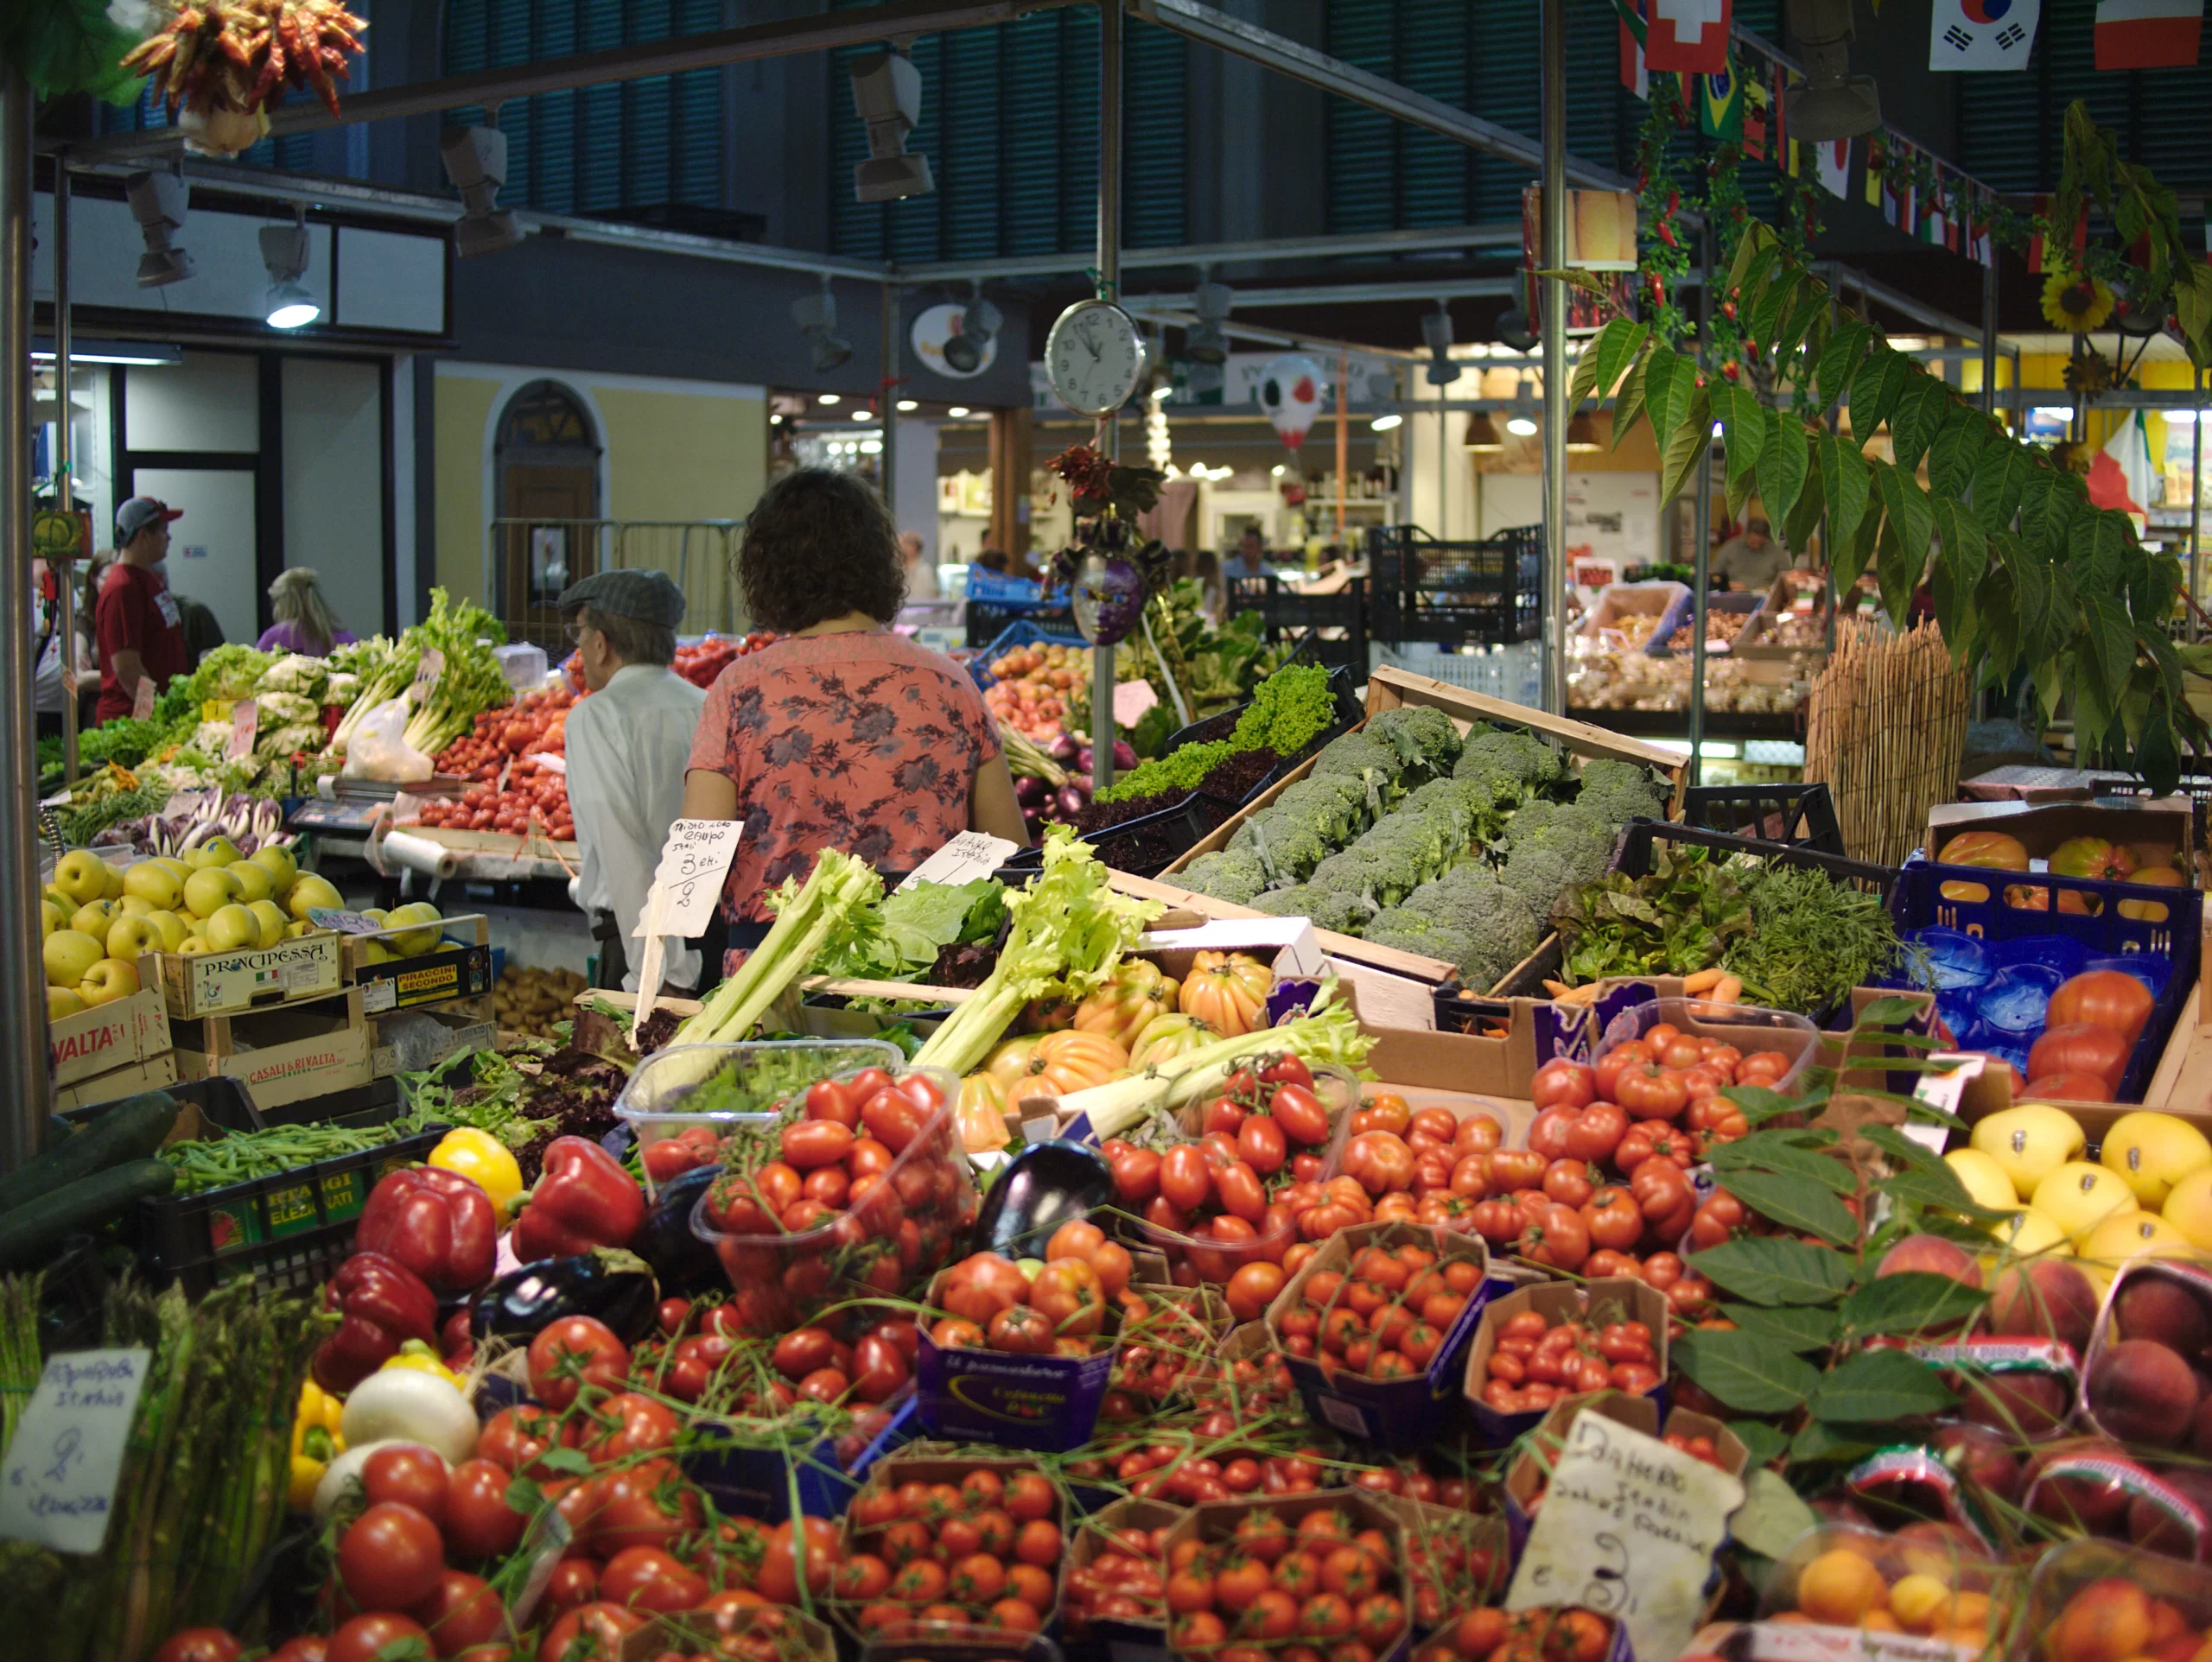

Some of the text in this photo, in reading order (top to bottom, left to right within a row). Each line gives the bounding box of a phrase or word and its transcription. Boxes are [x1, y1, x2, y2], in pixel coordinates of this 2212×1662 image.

[1085, 313, 1100, 326] 12
[1107, 317, 1114, 328] 1
[1118, 328, 1128, 341] 2
[1062, 339, 1076, 351] 10
[1126, 347, 1135, 360] 3
[1061, 359, 1070, 372] 9
[1124, 368, 1132, 378] 4
[1068, 377, 1077, 390] 8
[1114, 384, 1122, 396] 5
[1079, 390, 1089, 403] 7
[1098, 393, 1107, 405] 6
[681, 853, 696, 875] 3
[677, 881, 695, 908] 2
[398, 966, 456, 984] PIRACCINI
[402, 974, 454, 991] SECONDO
[250, 1063, 286, 1083] CASALI
[295, 1052, 337, 1071] RIVALTA
